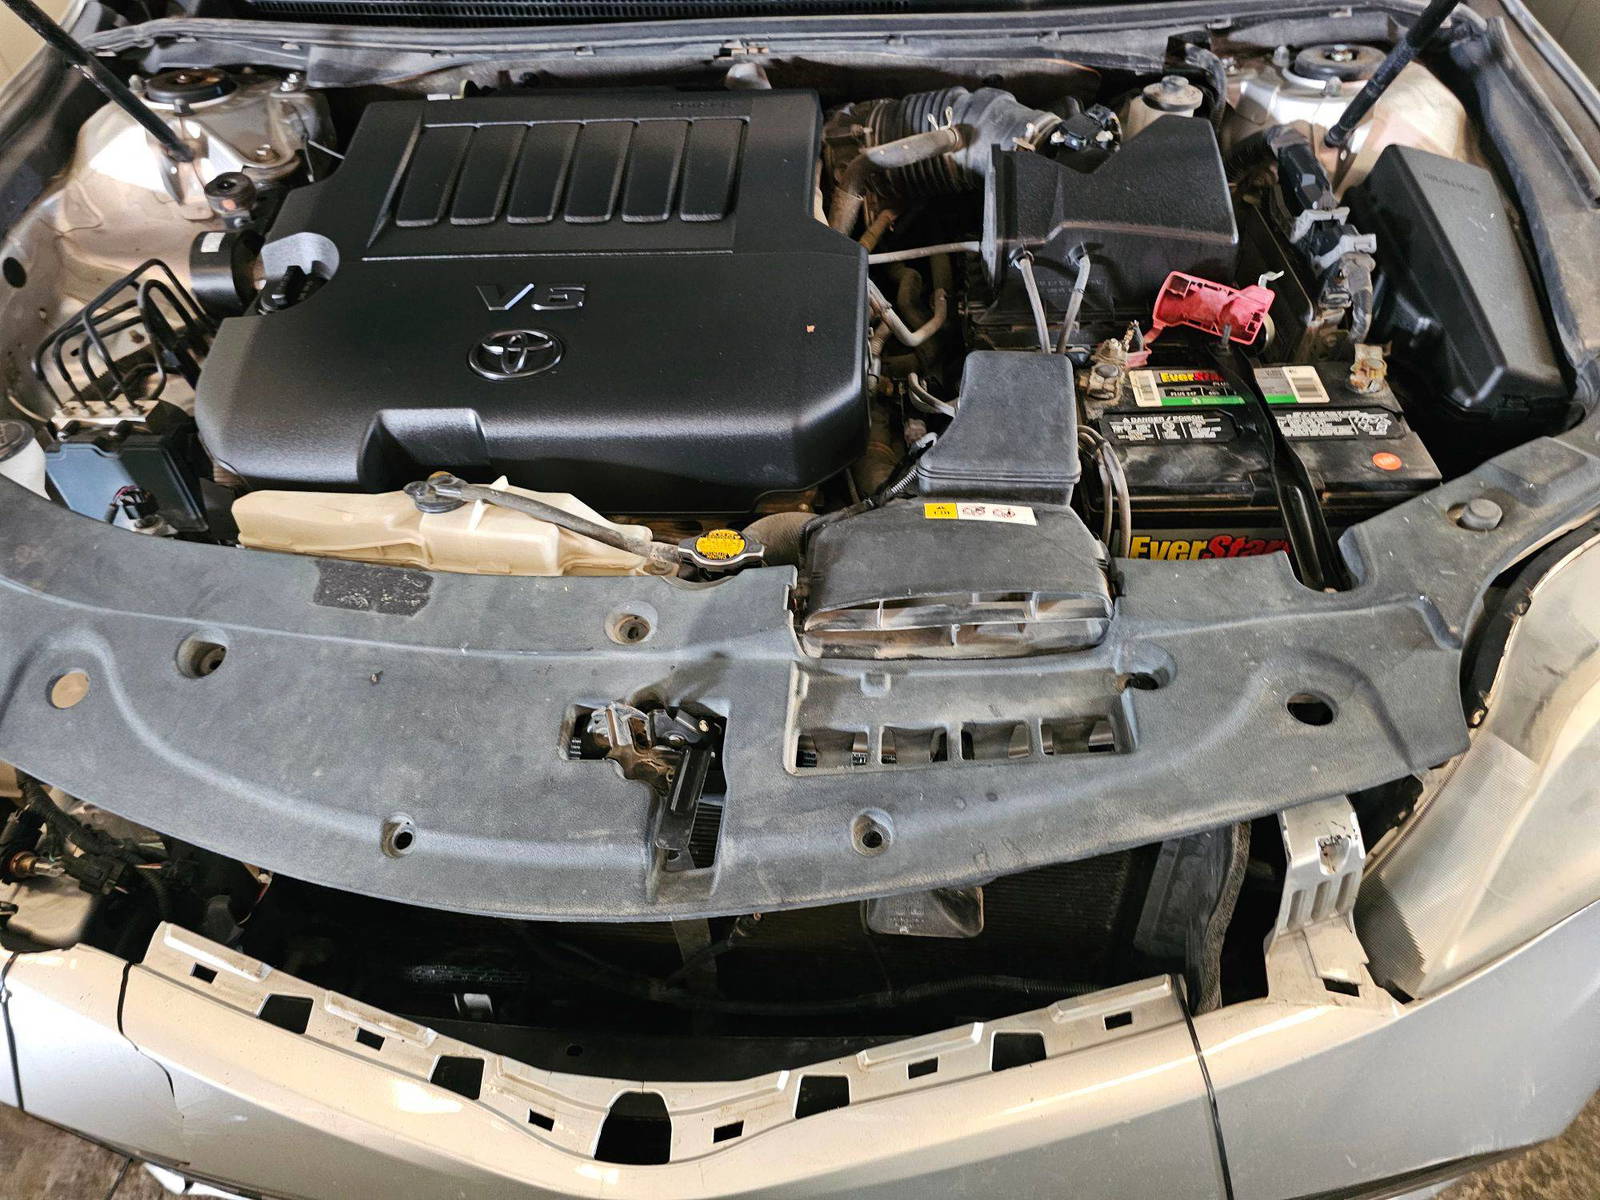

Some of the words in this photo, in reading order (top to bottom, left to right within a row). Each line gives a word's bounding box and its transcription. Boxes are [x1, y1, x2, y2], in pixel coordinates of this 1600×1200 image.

[474, 283, 585, 311] V6
[1130, 416, 1165, 424] DANGER
[1172, 414, 1204, 423] POISON
